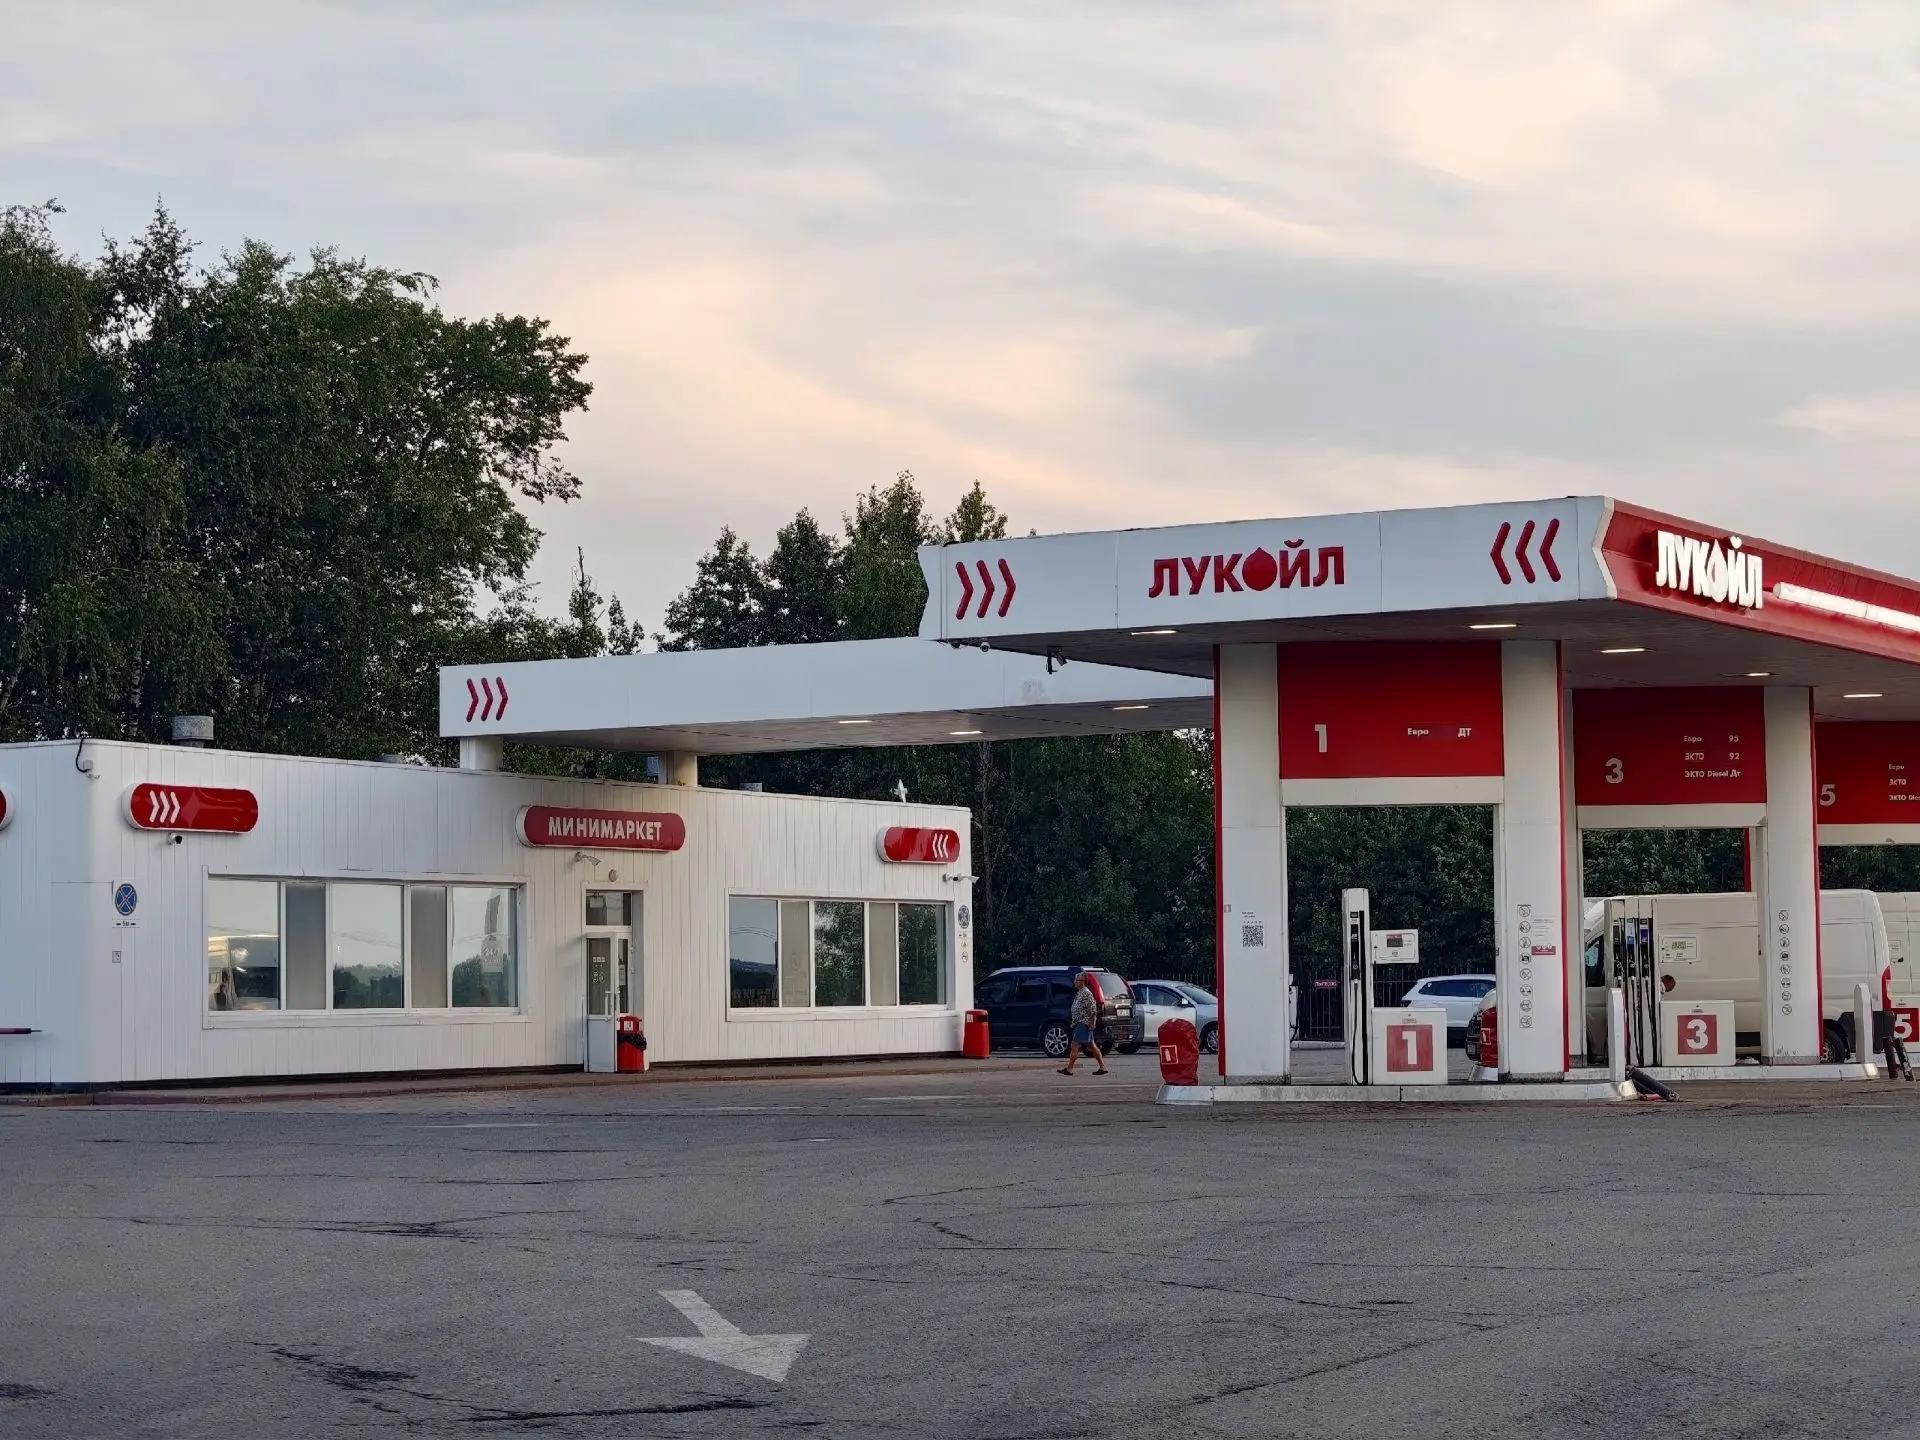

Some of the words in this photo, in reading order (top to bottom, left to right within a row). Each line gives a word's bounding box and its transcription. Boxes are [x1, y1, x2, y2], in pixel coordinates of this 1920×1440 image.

[1149, 539, 1344, 598] ЛУКОЙЛ
[1656, 530, 1763, 609] ЛУКОЙЛ
[1315, 724, 1327, 752] 1
[1407, 728, 1429, 737] Евро
[1457, 727, 1472, 738] ДТ
[1728, 734, 1739, 743] 95
[1684, 752, 1705, 761] ЭКТО
[1729, 752, 1740, 760] 92
[1605, 758, 1624, 784] 3
[1684, 770, 1705, 778] ЭКТО
[1820, 784, 1836, 807] 5
[548, 816, 663, 841] МИНИМАРКЕТ
[1687, 1018, 1709, 1049] 3
[1894, 1013, 1912, 1040] 5
[1402, 1030, 1417, 1065] 1
